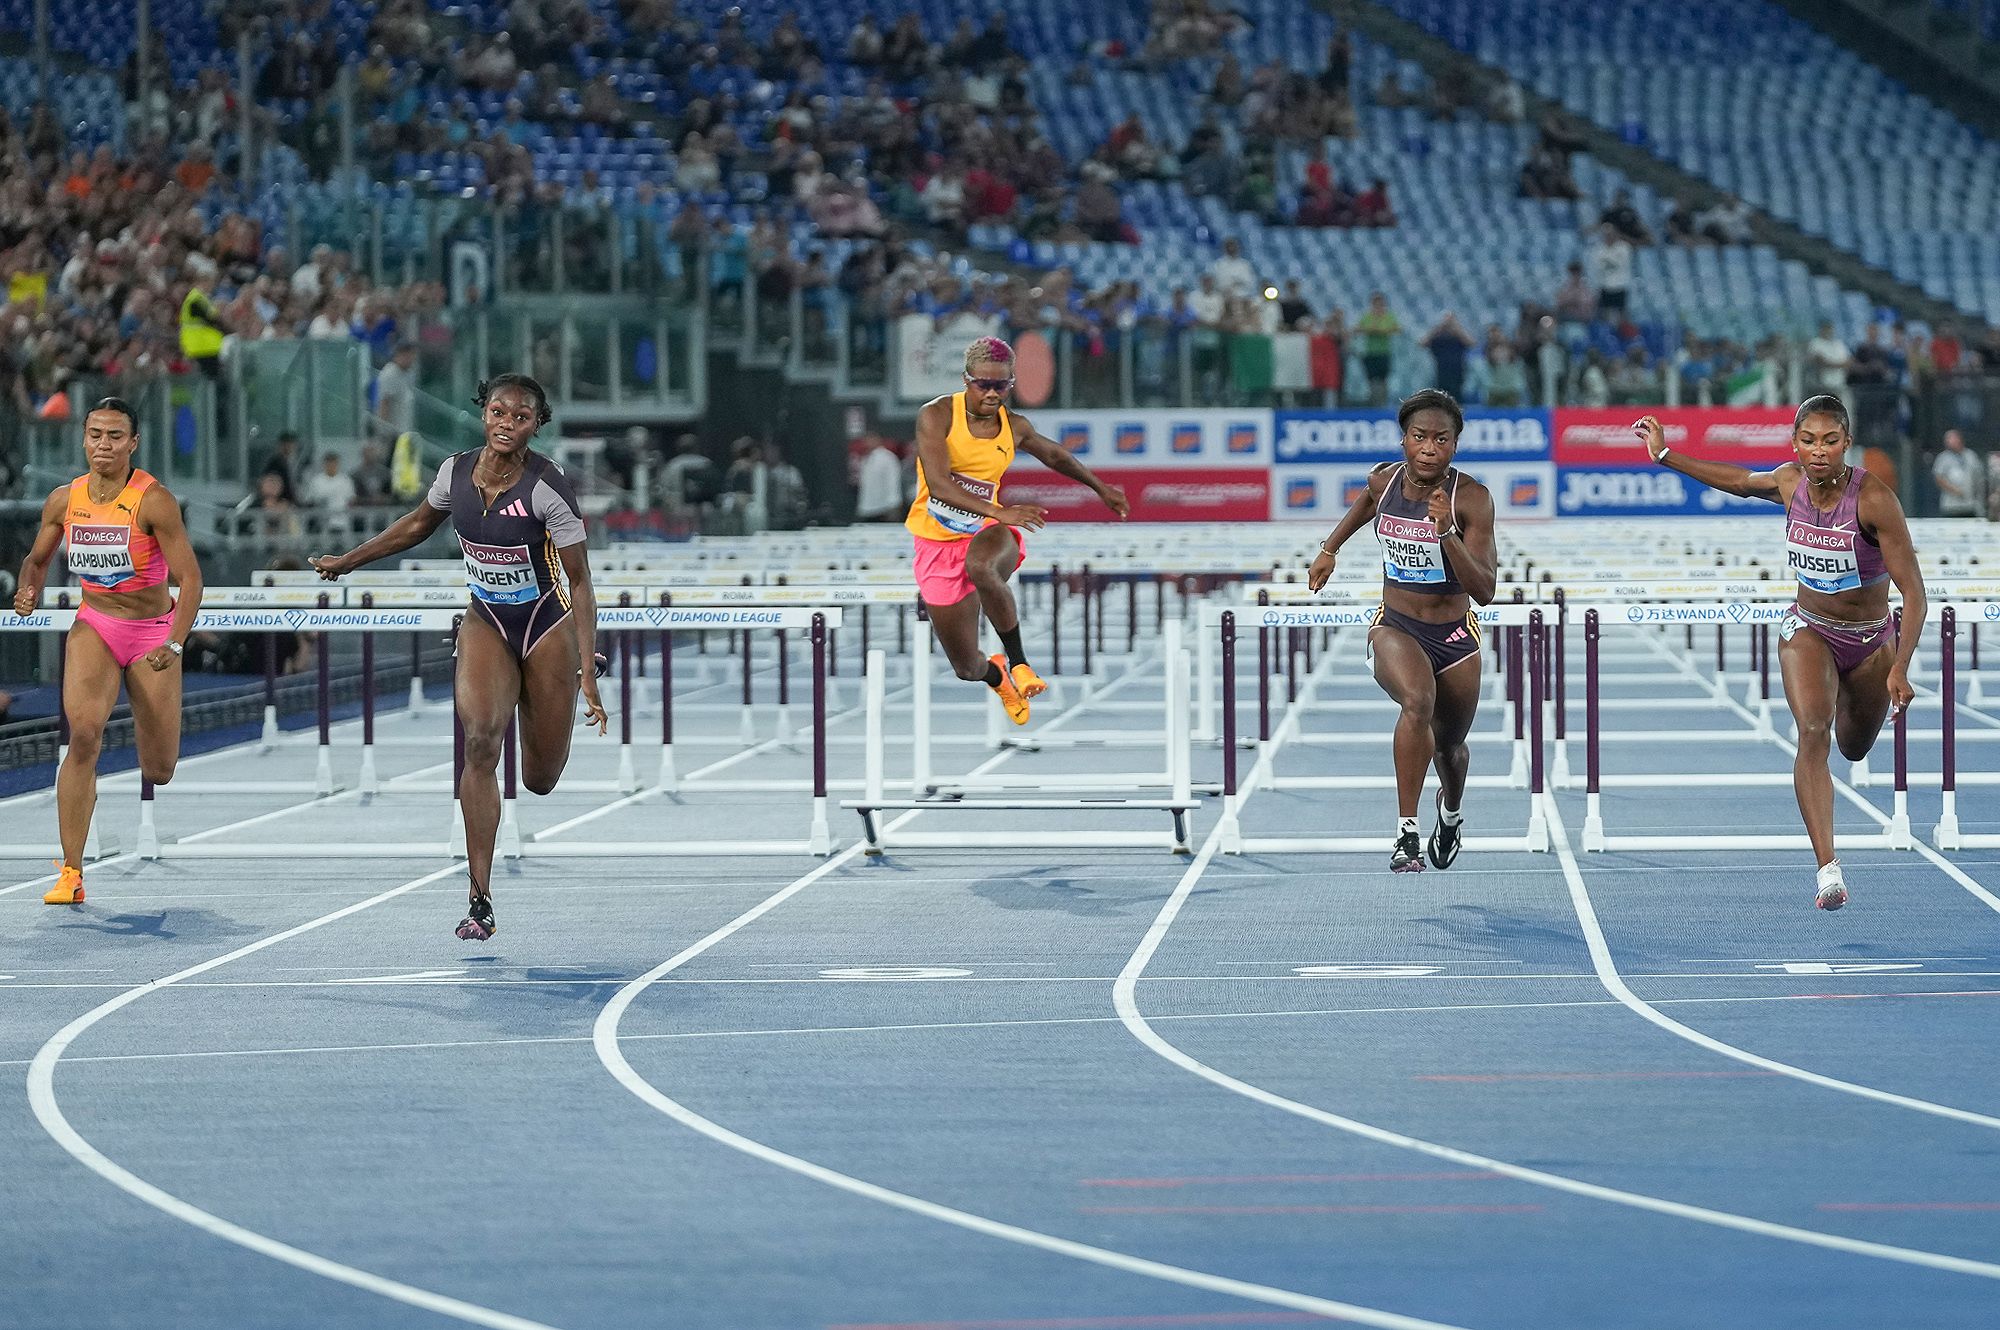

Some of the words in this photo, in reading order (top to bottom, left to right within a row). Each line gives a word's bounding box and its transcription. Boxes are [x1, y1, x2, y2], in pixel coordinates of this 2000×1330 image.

[84, 532, 123, 542] OMEGA
[1394, 525, 1433, 539] OMEGA
[1807, 533, 1846, 548] OMEGA
[1385, 539, 1431, 556] SAMBA-
[69, 552, 130, 568] KAMBUNDJI
[476, 551, 522, 562] OMEGA
[1788, 550, 1856, 574] RUSSELL
[465, 561, 532, 586] NUGENT
[1925, 586, 1948, 595] OMA
[309, 614, 369, 625] DIAMOND
[373, 614, 422, 625] LEAGUE
[596, 611, 645, 622] WANDA
[670, 612, 729, 623] DIAMOND
[733, 612, 782, 623] LEAGUE
[1477, 611, 1500, 621] GUE
[1752, 609, 1785, 620] DIAM
[2, 615, 52, 626] LEAGUE
